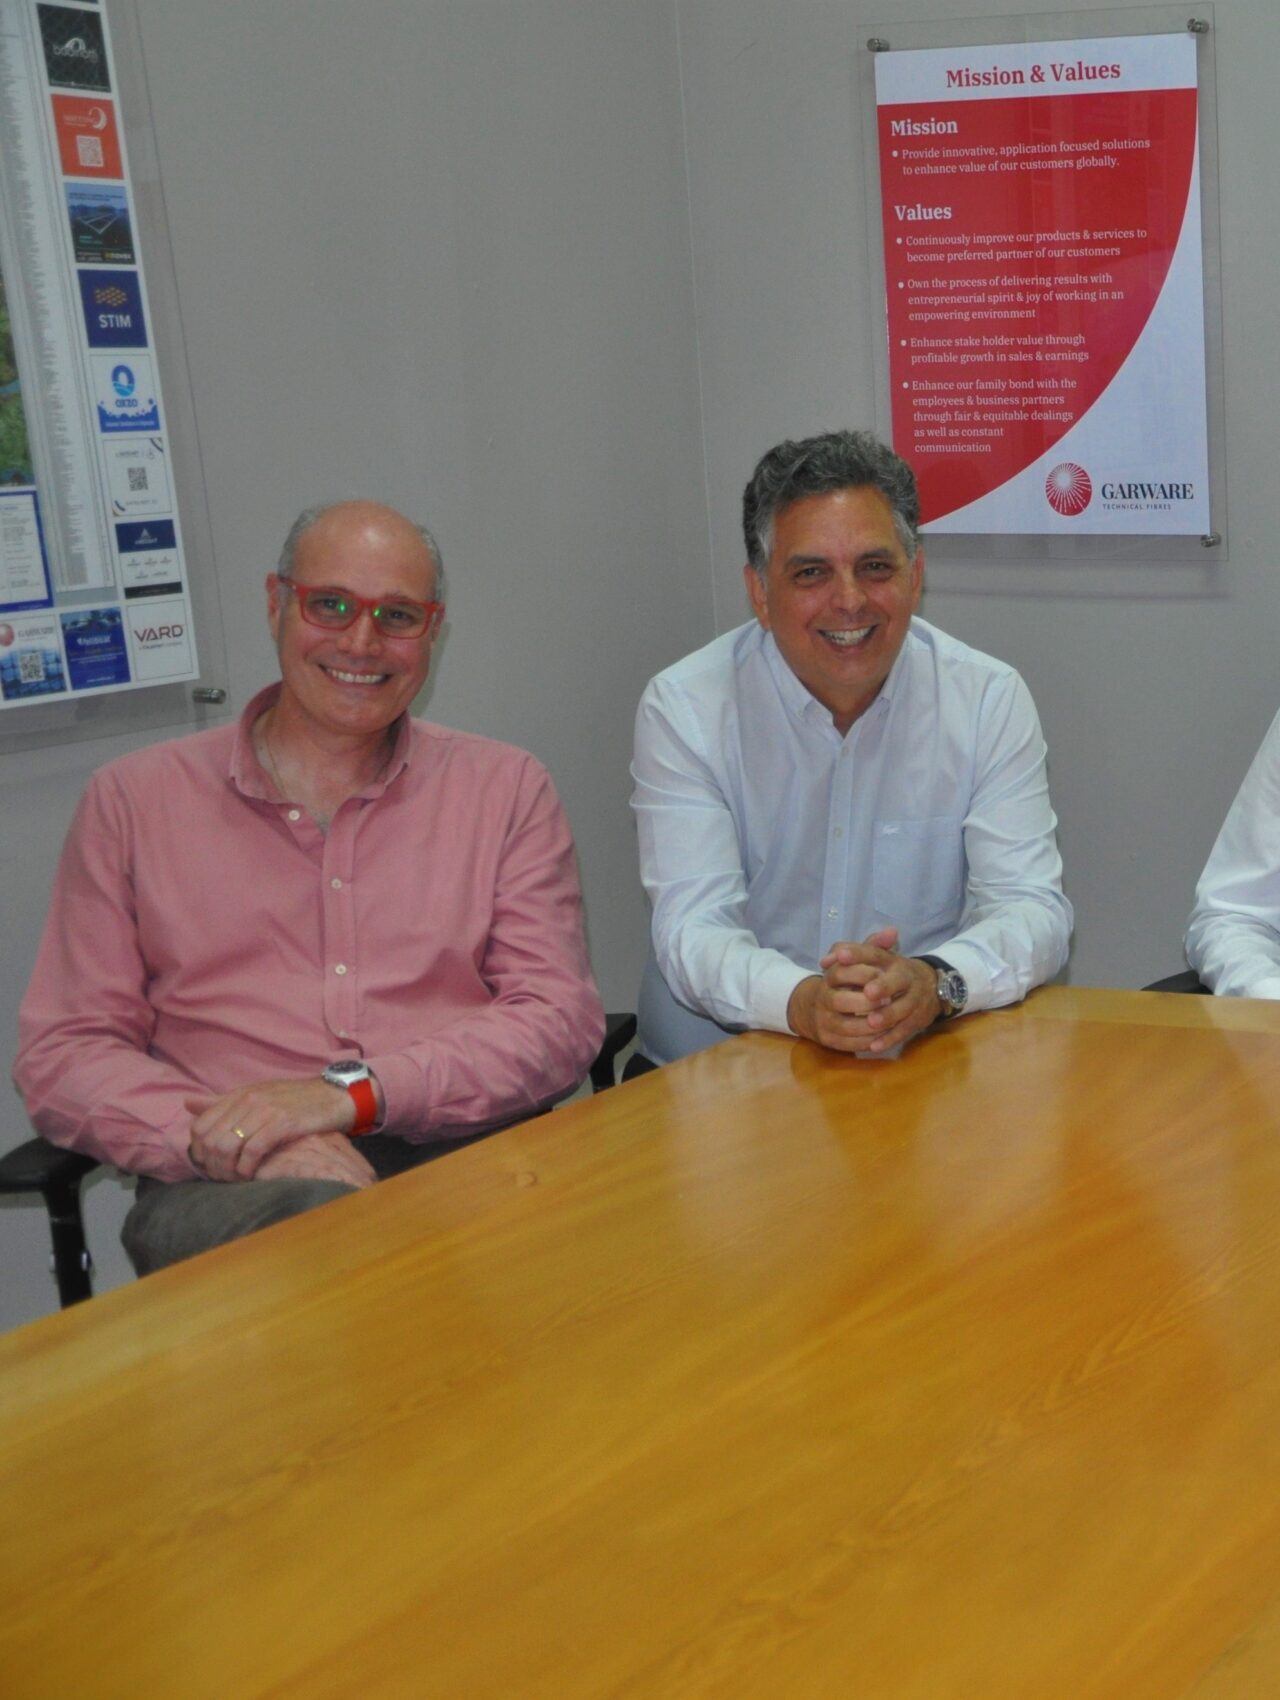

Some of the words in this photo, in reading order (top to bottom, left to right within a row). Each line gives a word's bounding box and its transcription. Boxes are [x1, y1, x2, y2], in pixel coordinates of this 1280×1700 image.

[947, 66, 1024, 87] Mission
[1030, 65, 1045, 83] &
[1050, 61, 1120, 81] Values
[891, 118, 958, 136] Mission
[902, 147, 940, 159] Provide
[942, 145, 997, 157] innovative,
[1000, 143, 1057, 157] application
[1060, 140, 1099, 152] focused
[1102, 139, 1150, 149] solutions
[903, 167, 912, 175] to
[915, 164, 957, 174] enhance
[959, 162, 986, 172] value
[988, 160, 999, 171] of
[1000, 162, 1018, 170] our
[1020, 160, 1074, 169] customers
[1076, 155, 1119, 169] globally.
[895, 204, 952, 220] Values
[906, 234, 970, 246] Continuously
[973, 233, 1014, 245] improve
[1016, 234, 1034, 242] our
[1036, 230, 1080, 243] products
[1083, 230, 1090, 239] &
[1093, 229, 1134, 239] services
[1137, 229, 1147, 237] to
[907, 252, 945, 262] become
[947, 249, 993, 263] preferred
[996, 250, 1033, 261] partner
[1036, 247, 1046, 257] of
[1048, 249, 1065, 257] our
[1067, 248, 1120, 257] customers
[908, 279, 929, 288] Own
[932, 278, 947, 288] the
[949, 278, 987, 290] process
[989, 276, 1000, 286] of
[1001, 275, 1052, 287] delivering
[1054, 274, 1088, 284] results
[1090, 273, 1112, 283] with
[908, 293, 985, 306] entrepreneurial
[988, 292, 1013, 304] spirit
[1016, 292, 1024, 301] &
[1026, 292, 1041, 304] joy
[1043, 290, 1054, 301] of
[1055, 290, 1096, 302] working
[1099, 290, 1109, 299] in
[1111, 291, 1124, 299] an
[98, 314, 132, 328] STIM
[909, 310, 970, 322] empowering
[972, 309, 1035, 319] environment
[911, 337, 953, 347] Enhance
[955, 336, 980, 346] stake
[983, 336, 1014, 345] holder
[1016, 335, 1044, 345] value
[1046, 334, 1085, 346] through
[912, 352, 958, 365] profitable
[960, 352, 994, 364] growth
[997, 352, 1006, 361] in
[1008, 351, 1033, 361] sales
[1036, 351, 1043, 360] &
[1045, 350, 1088, 362] earnings
[913, 380, 954, 390] Enhance
[976, 379, 1007, 391] family
[1009, 379, 1034, 389] bond
[1037, 378, 1058, 388] with
[1061, 378, 1076, 388] the
[913, 396, 964, 407] employees
[967, 396, 974, 405] &
[976, 395, 1019, 405] business
[1022, 396, 1064, 406] partners
[914, 411, 952, 423] through
[954, 411, 971, 421] fair
[973, 411, 981, 421] &
[982, 410, 1029, 423] equitable
[1031, 410, 1074, 423] dealings
[914, 429, 925, 437] as
[927, 427, 946, 436] well
[961, 428, 1003, 436] constant
[915, 443, 991, 452] communication
[1102, 484, 1193, 499] GARWARE
[134, 625, 184, 642] VARD
